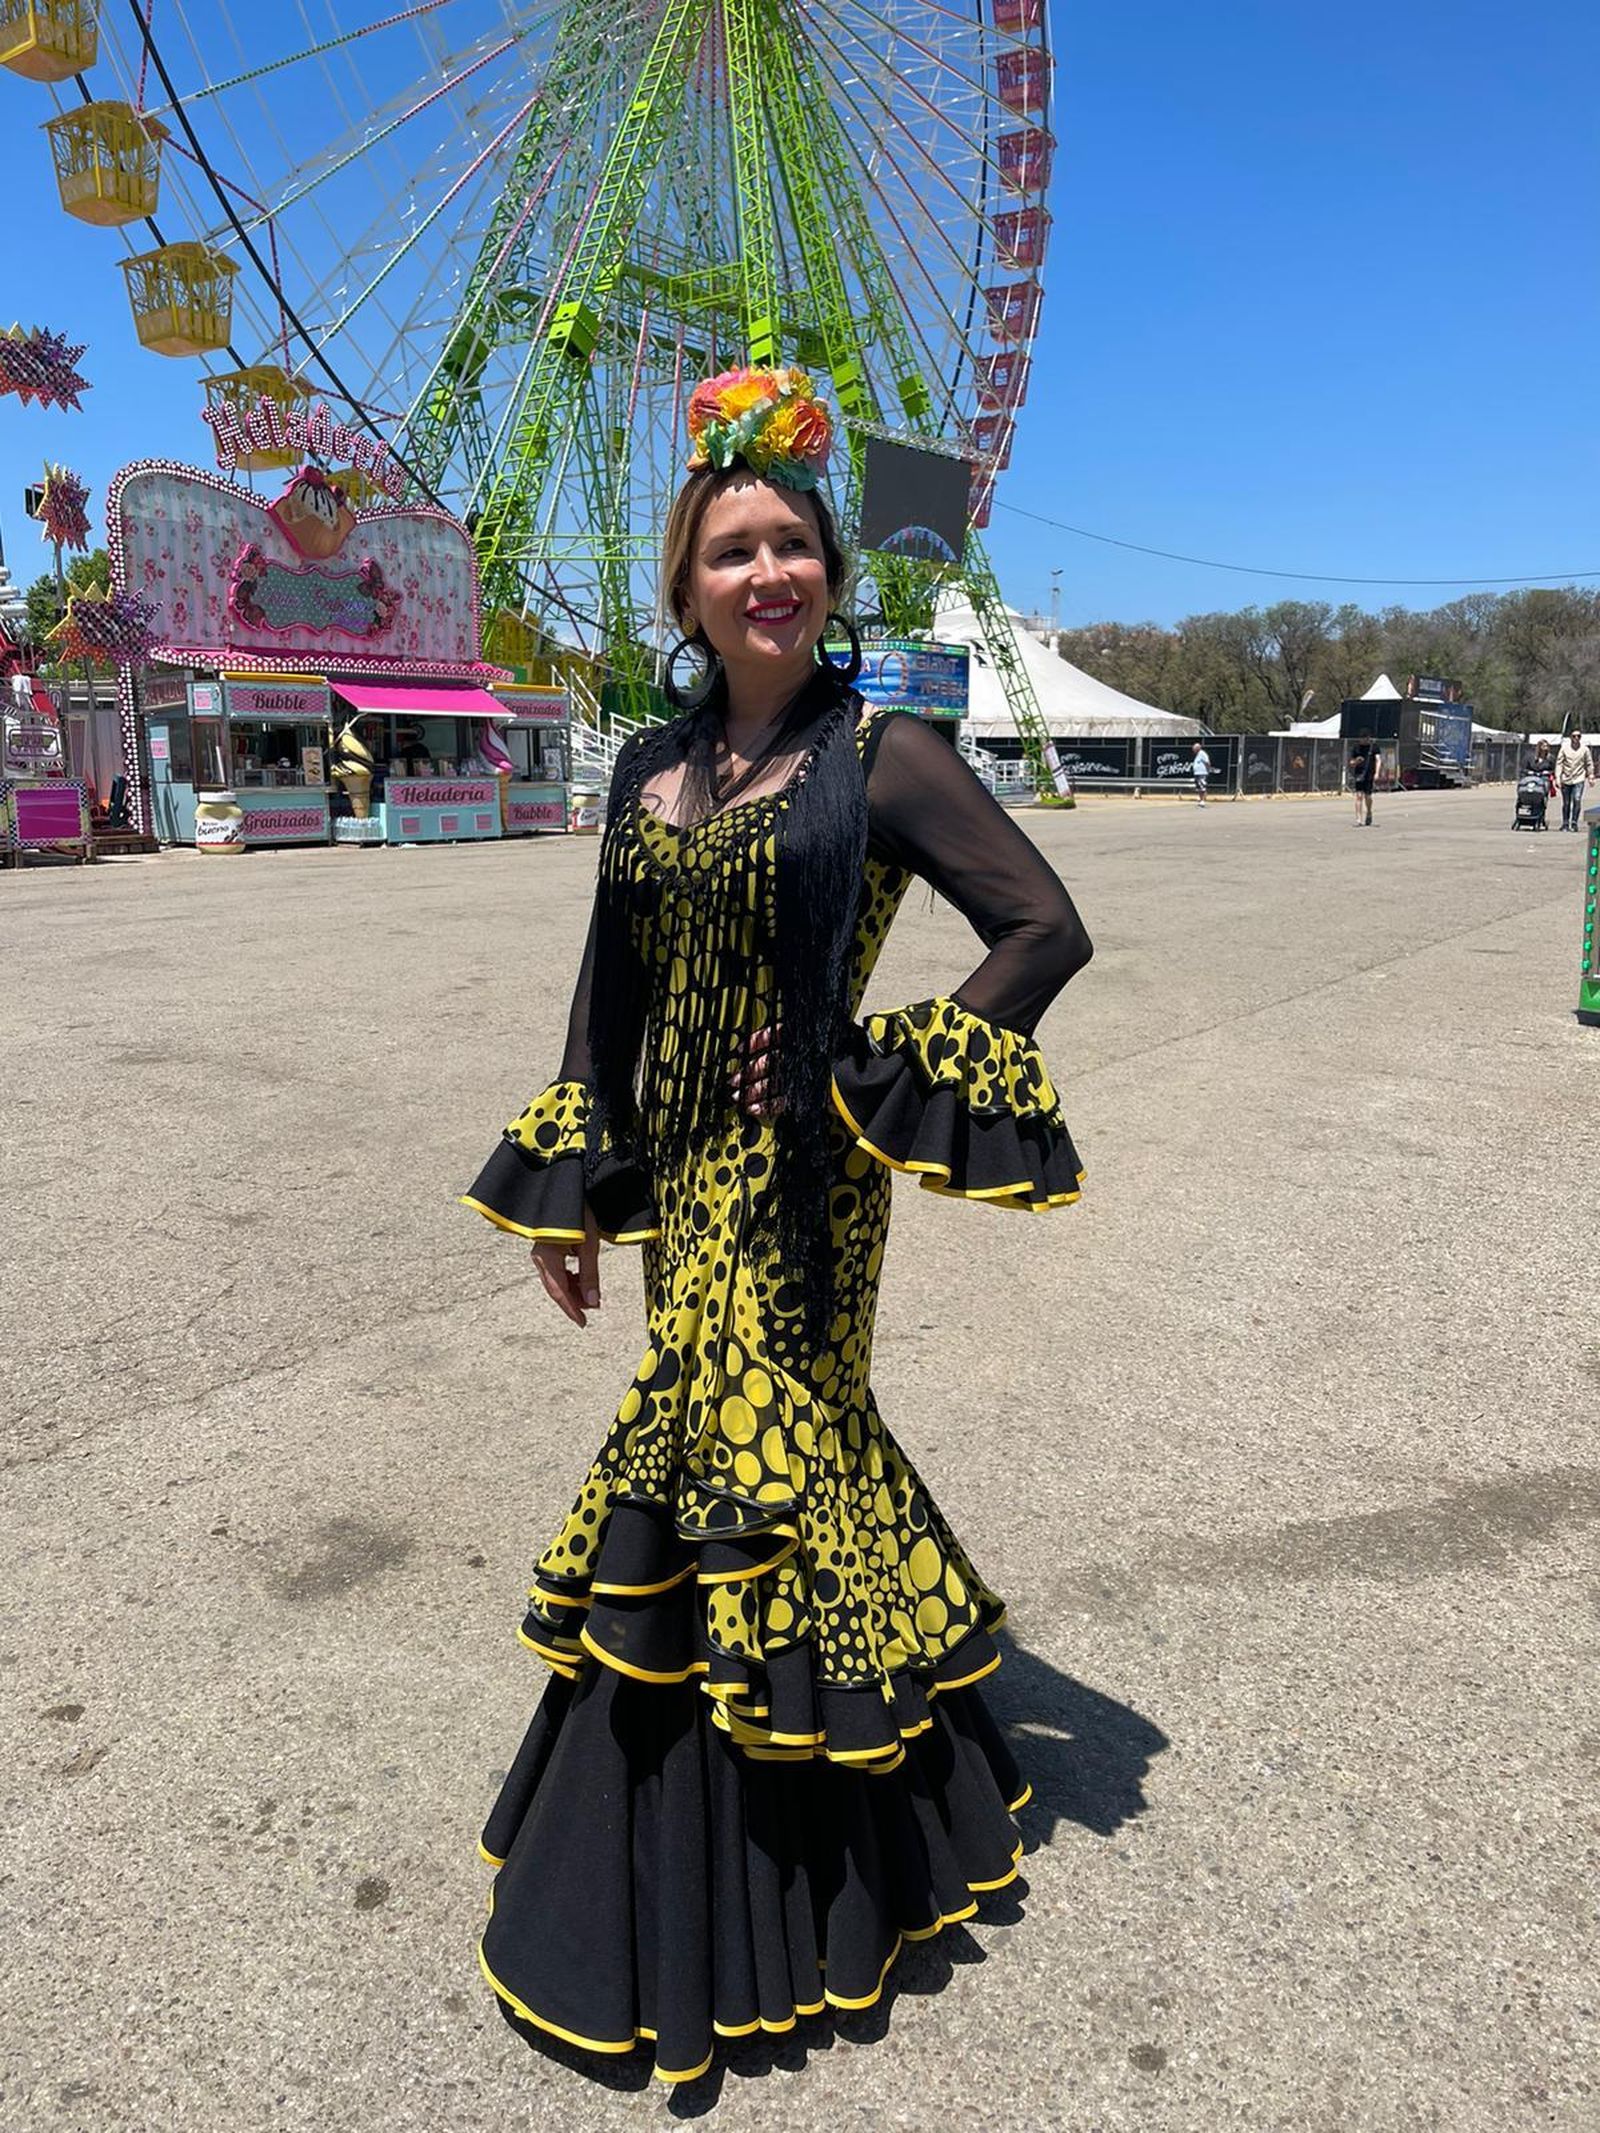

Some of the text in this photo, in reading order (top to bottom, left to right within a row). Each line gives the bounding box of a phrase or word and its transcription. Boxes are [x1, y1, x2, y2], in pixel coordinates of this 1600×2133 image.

[252, 692, 307, 709] Bubble
[514, 804, 552, 820] Bubble
[243, 812, 319, 832] Granizados
